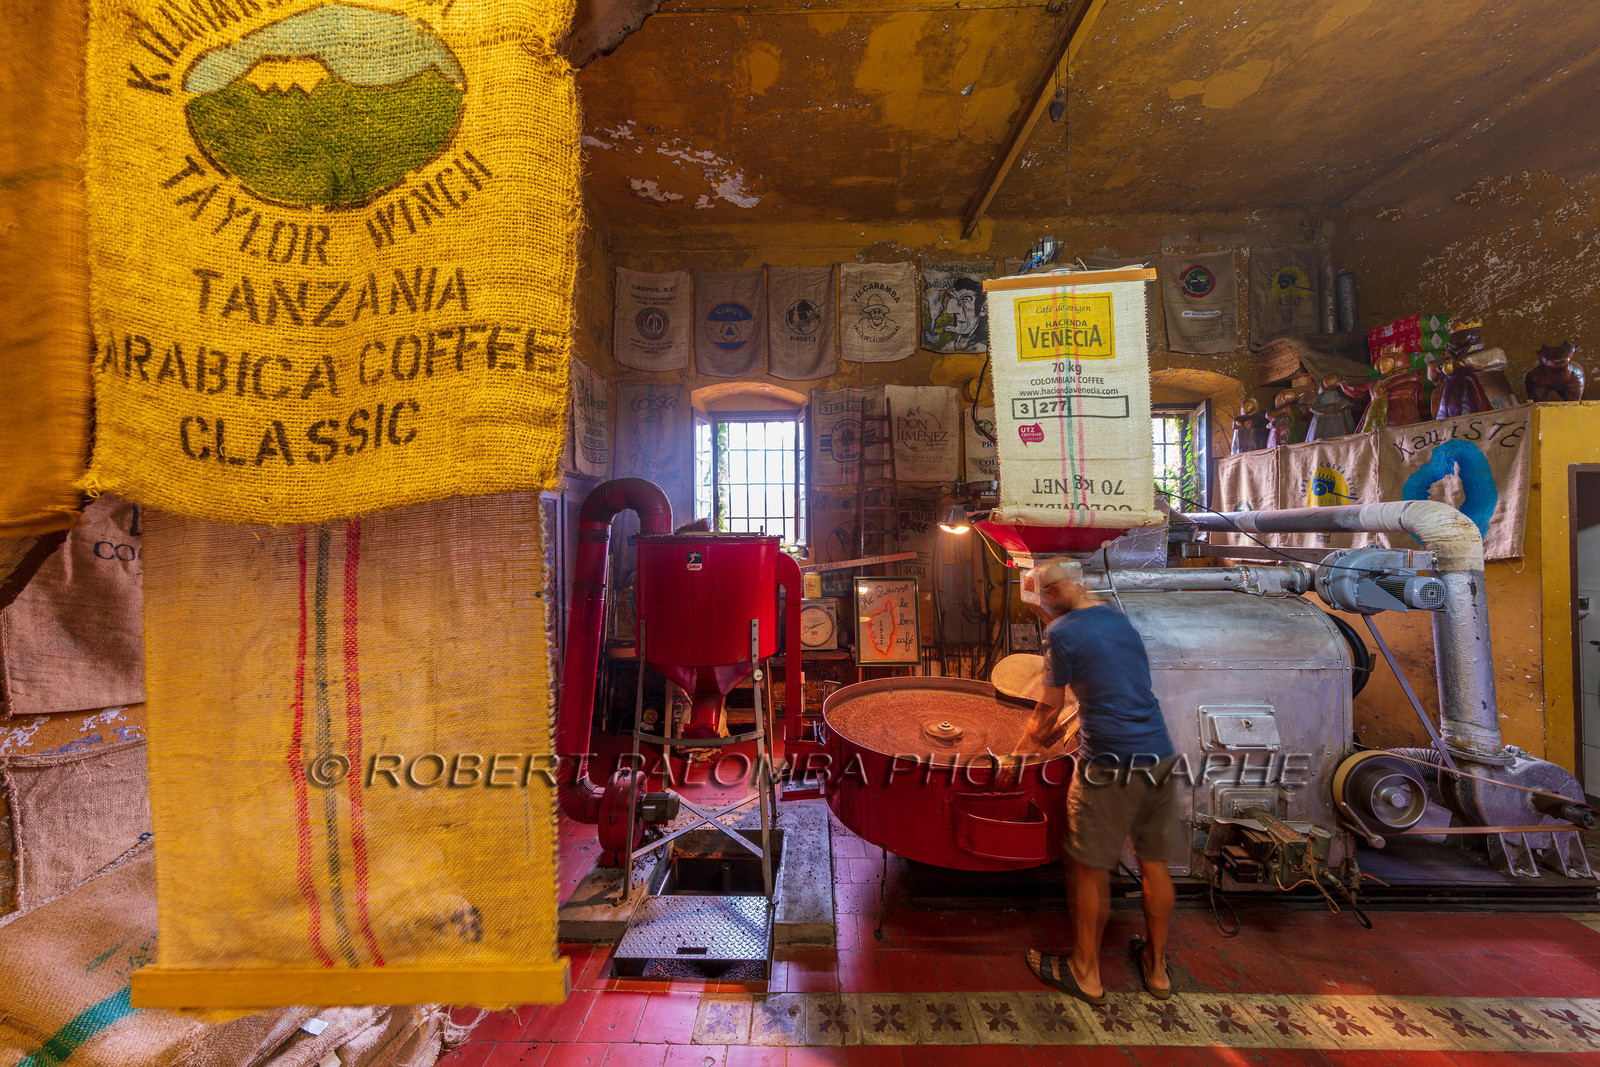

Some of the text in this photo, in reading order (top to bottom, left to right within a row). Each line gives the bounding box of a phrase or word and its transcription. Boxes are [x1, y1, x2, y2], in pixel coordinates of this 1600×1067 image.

[161, 150, 495, 266] TAYLOR WINCH
[192, 266, 471, 327] TANZANIA
[851, 282, 900, 304] VILCABAMBA
[1035, 304, 1053, 316] Café
[1066, 304, 1091, 315] origen
[1045, 319, 1088, 328] HACIENDA
[1027, 324, 1103, 349] VENECIA
[100, 325, 558, 400] ARABICA COFFEE
[1051, 360, 1082, 375] 70 kg
[1030, 376, 1105, 386] COLOMBIAN COFFEE
[1019, 387, 1119, 397] www.haciendavenecia.com
[1020, 400, 1067, 414] 3 277
[897, 416, 928, 430] DON
[180, 399, 420, 468] CLASSIC
[896, 430, 949, 443] JIMENEZ
[1320, 461, 1346, 475] COSTA
[1031, 474, 1125, 496] 70 kg NET
[911, 511, 937, 522] SIGRI
[93, 540, 142, 562] CO
[874, 584, 909, 599] Rousse
[897, 613, 914, 626] bon
[896, 631, 914, 652] café
